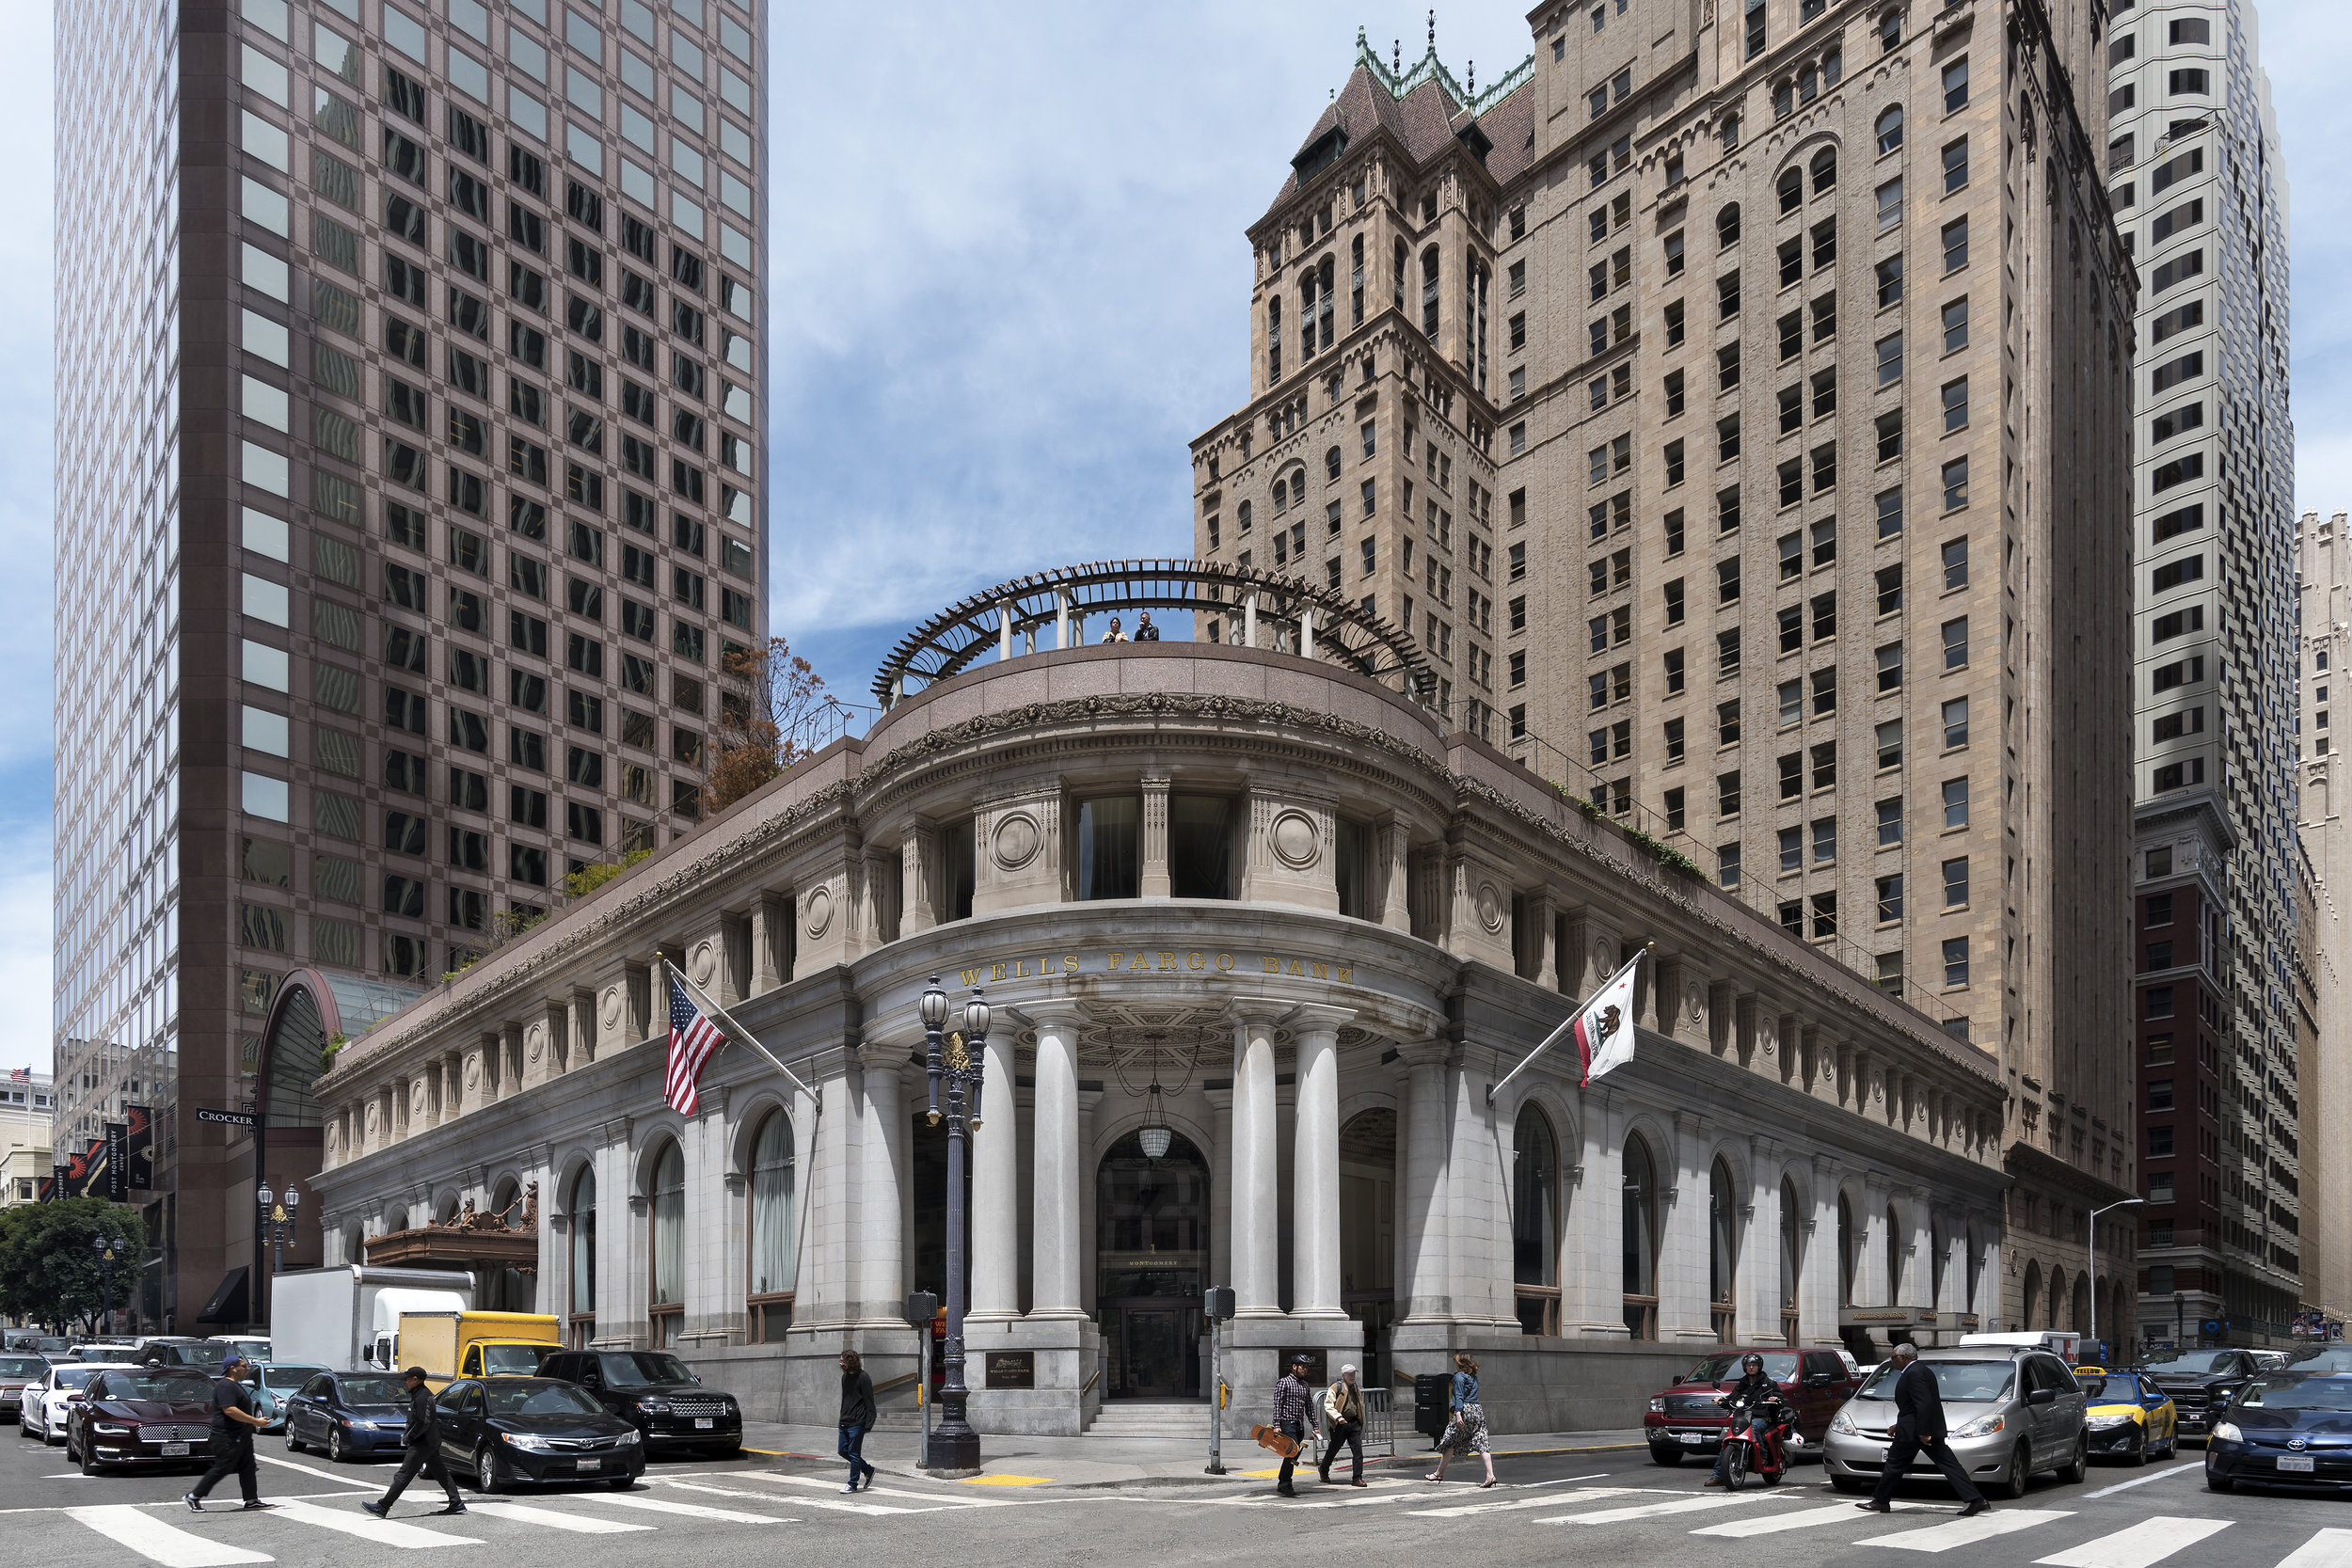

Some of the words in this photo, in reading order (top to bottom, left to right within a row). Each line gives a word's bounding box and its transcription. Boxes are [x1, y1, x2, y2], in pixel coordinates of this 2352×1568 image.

[960, 955, 1079, 986] WELLS
[1107, 952, 1234, 971] FARGO
[1262, 956, 1353, 984] BANK
[199, 1111, 253, 1125] CROCKER
[1151, 1243, 1156, 1255] 1
